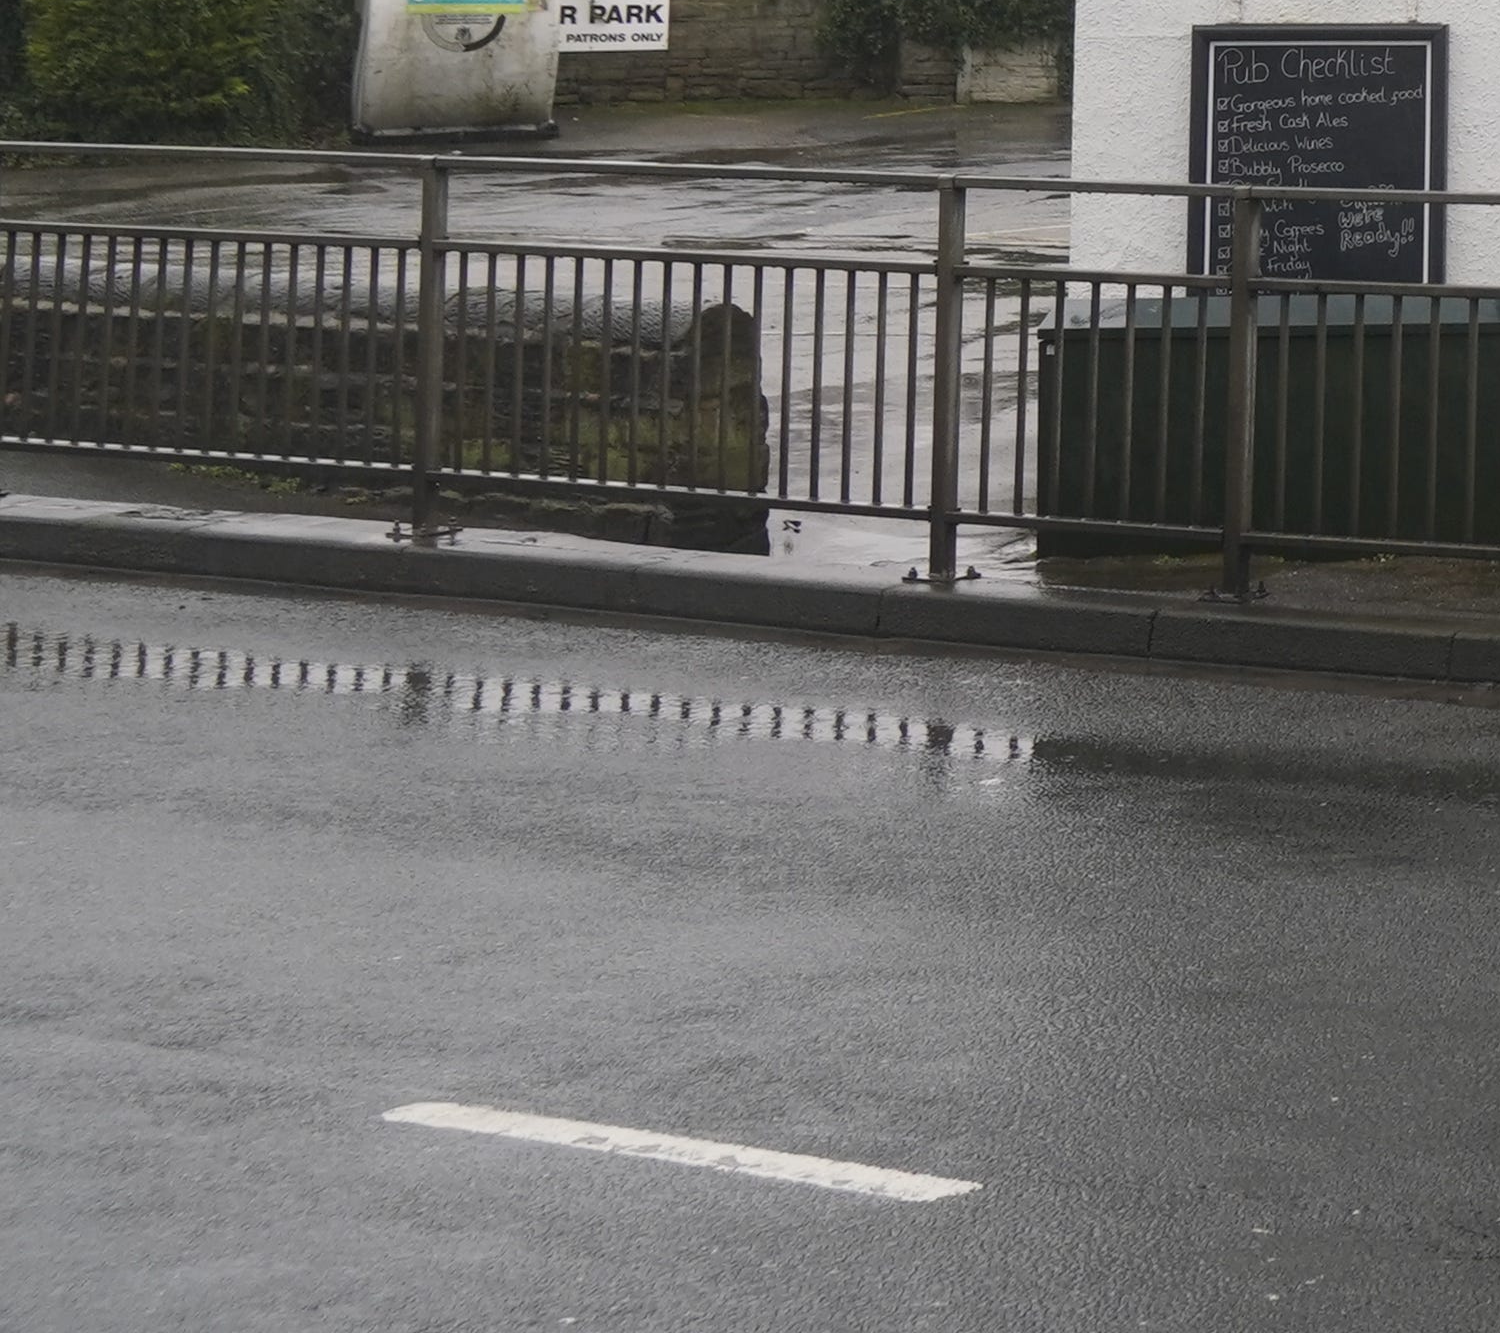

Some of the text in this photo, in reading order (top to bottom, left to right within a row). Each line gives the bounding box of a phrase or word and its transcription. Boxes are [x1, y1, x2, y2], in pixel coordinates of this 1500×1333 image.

[589, 4, 664, 24] PARK
[566, 32, 663, 43] PATRONS ONLY
[1218, 47, 1396, 84] Pub Checklist
[1230, 84, 1424, 116] Gorgeous home cooked food
[1231, 112, 1349, 133] Fresh Cask Ales
[1229, 134, 1334, 154] Delicious Wines
[1230, 157, 1283, 185] Bubbly
[1287, 155, 1345, 174] Prosecco
[1340, 219, 1415, 257] Ready!!
[1273, 238, 1312, 261] Night
[1267, 256, 1313, 278] Friday
